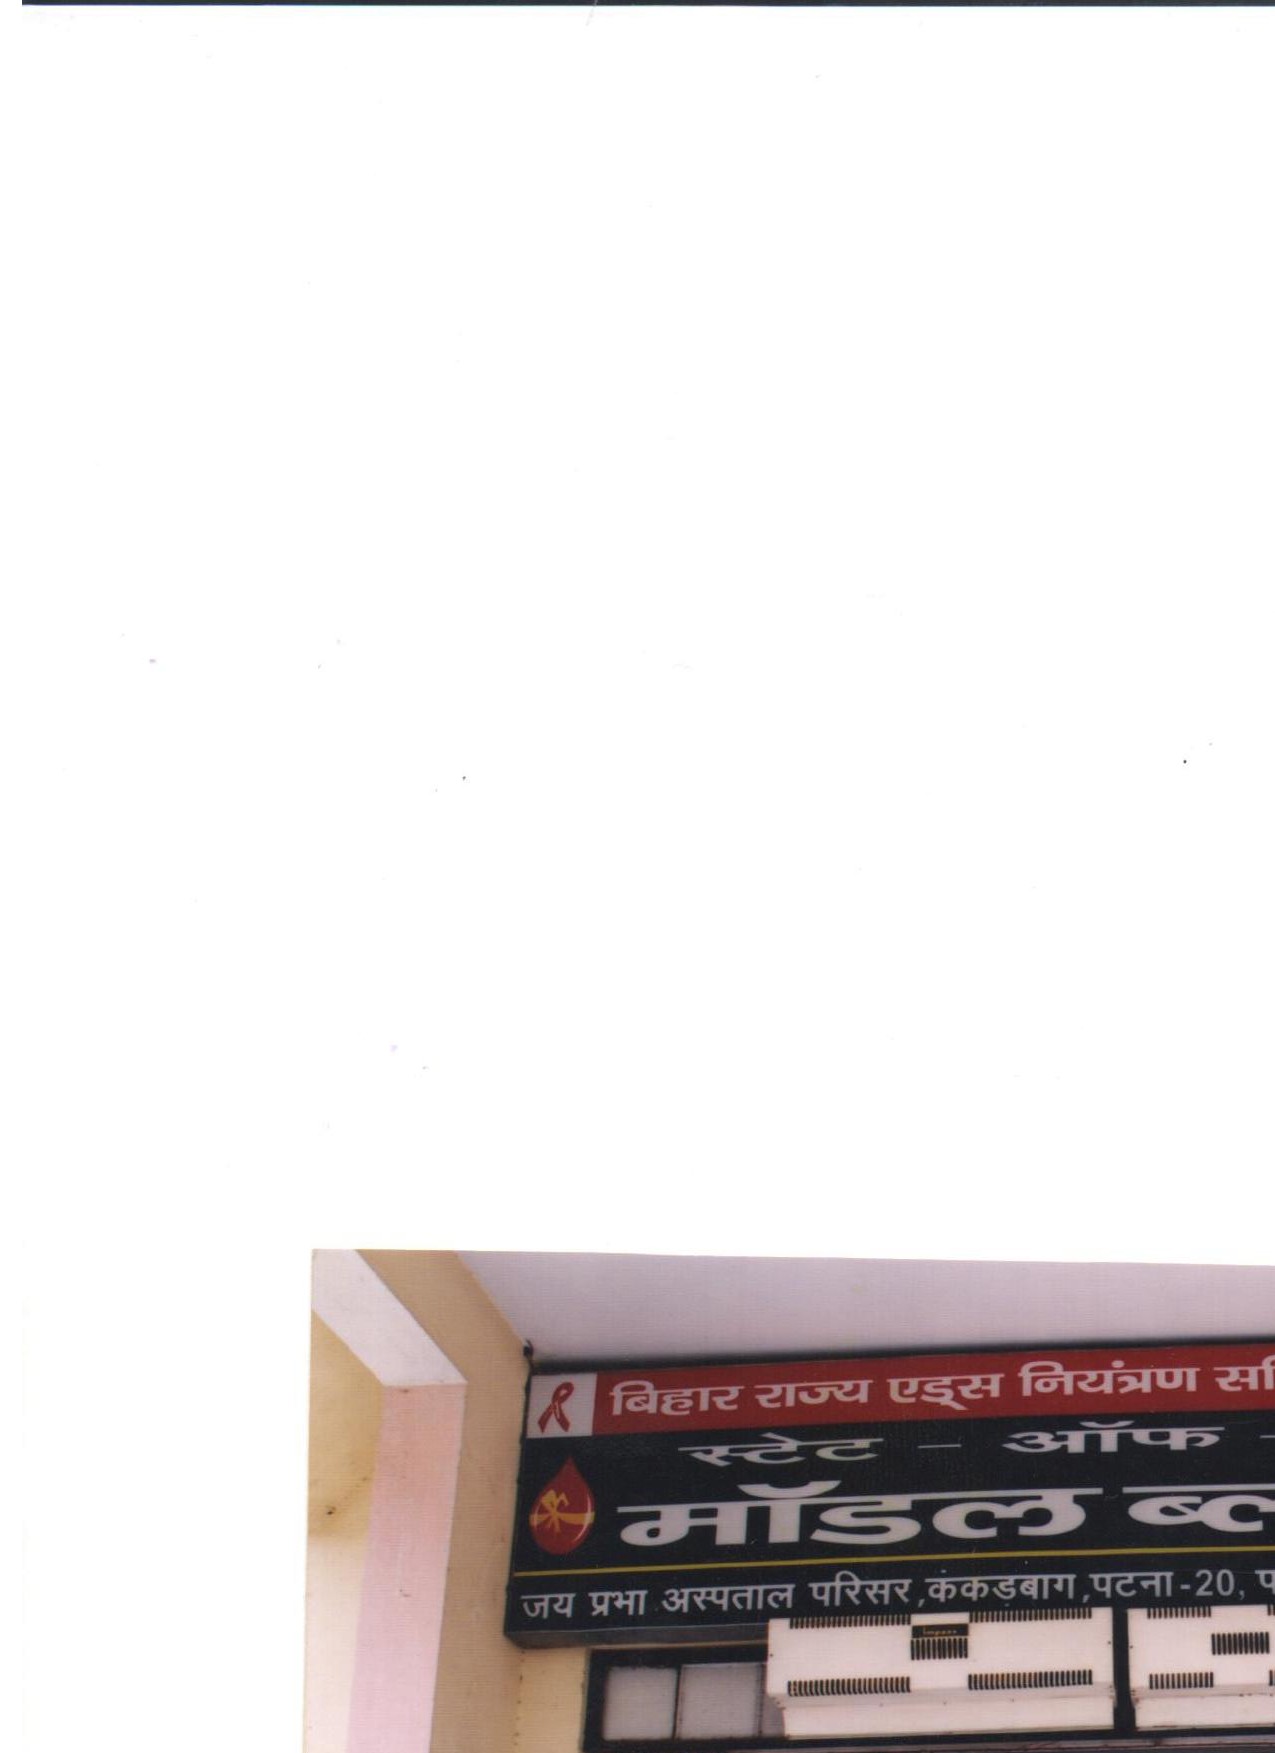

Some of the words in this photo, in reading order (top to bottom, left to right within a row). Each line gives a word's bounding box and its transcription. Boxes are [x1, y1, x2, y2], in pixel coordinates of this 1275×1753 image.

[611, 1380, 738, 1415] बिहार
[756, 1380, 872, 1409] राज्य
[888, 1373, 1004, 1410] एड्स
[1019, 1360, 1200, 1399] नियंत्रण
[678, 1432, 884, 1466] स्टेट
[1002, 1419, 1225, 1454] ऑफ
[617, 1480, 1104, 1545] मॉडल
[521, 1594, 573, 1619] जय
[590, 1590, 647, 1615] प्रभा
[663, 1583, 795, 1610] अस्पताल
